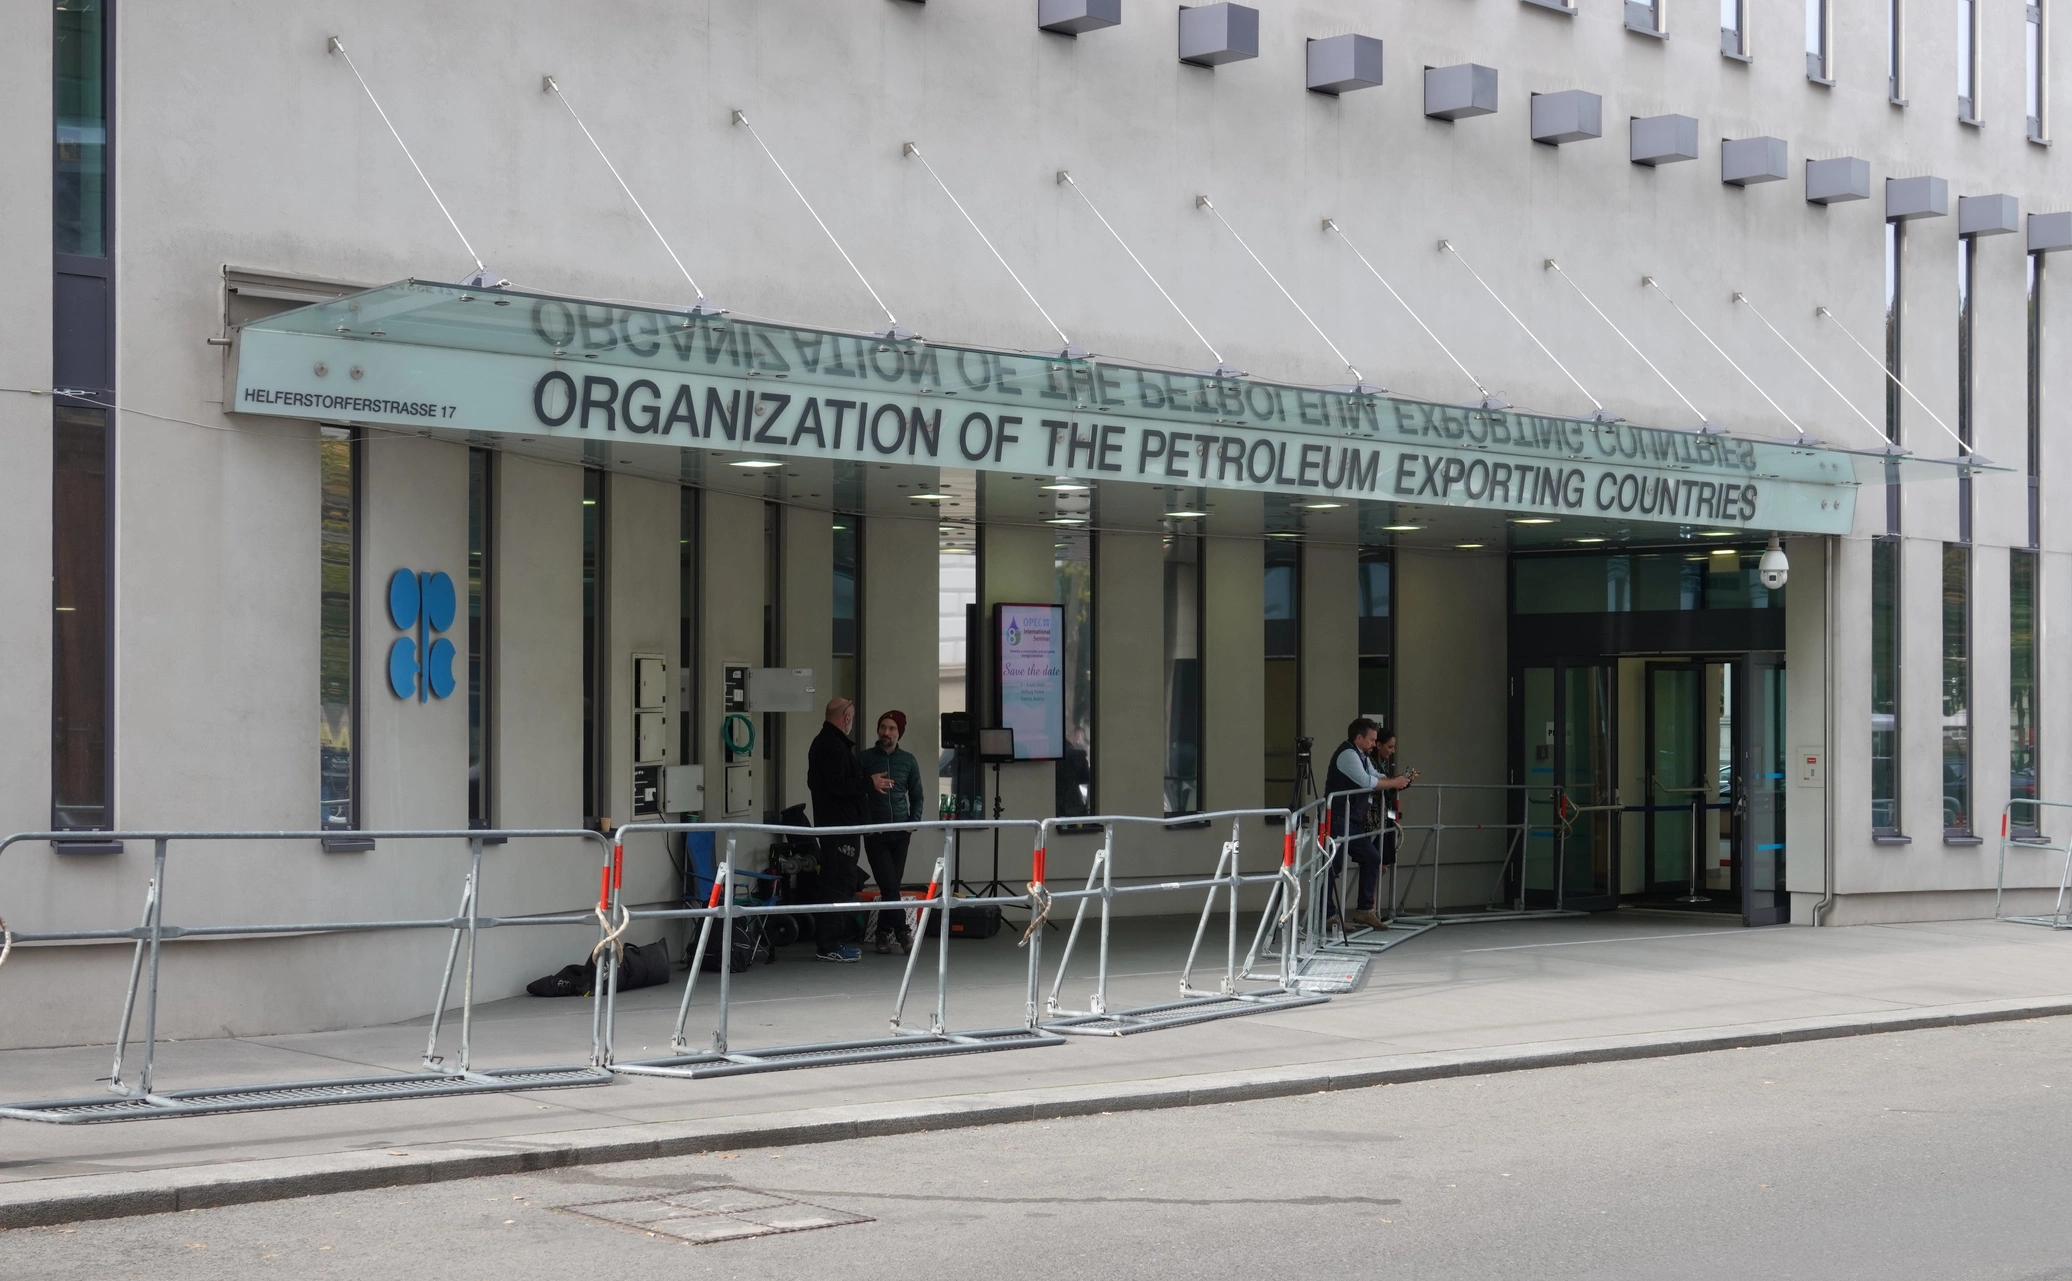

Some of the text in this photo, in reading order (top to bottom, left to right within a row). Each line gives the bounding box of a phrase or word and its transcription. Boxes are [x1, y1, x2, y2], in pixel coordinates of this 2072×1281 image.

[244, 387, 457, 419] HELFERSTORFERSTRASSE 17
[533, 370, 1758, 521] ORGANIZATION OF THE PETROLEUM EXPORTING COUNTRIES
[1023, 617, 1042, 627] OPEC
[1003, 662, 1061, 677] Save the date
